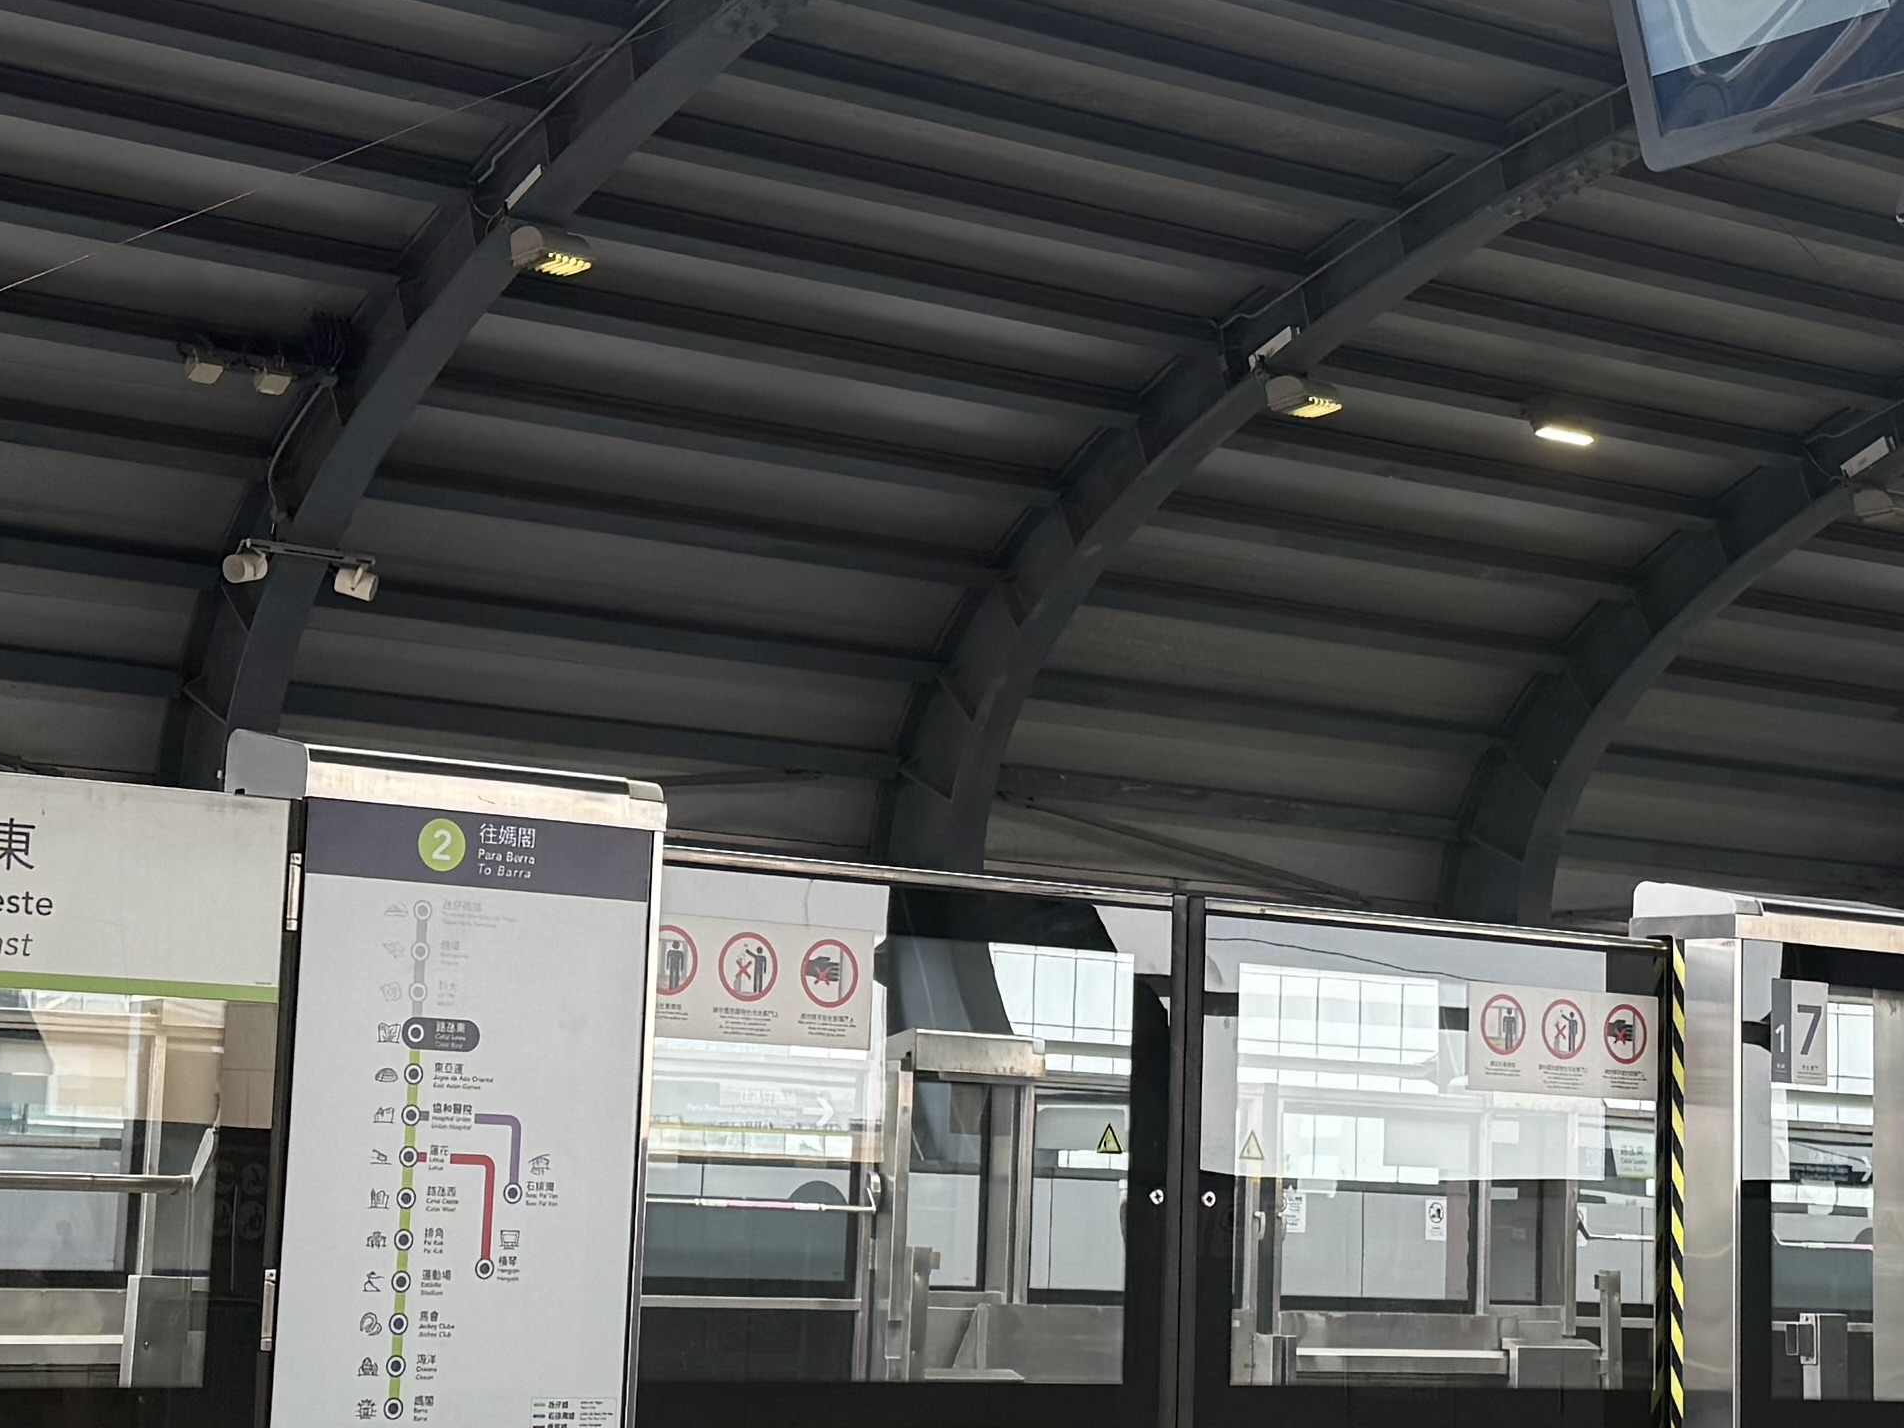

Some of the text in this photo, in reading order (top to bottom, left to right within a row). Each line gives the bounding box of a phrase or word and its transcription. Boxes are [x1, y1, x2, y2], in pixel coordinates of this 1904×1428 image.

[431, 828, 452, 861] 2
[478, 823, 536, 849] 往媽閣
[477, 848, 536, 865] Para Barra
[478, 863, 532, 879] To Barra
[1774, 1024, 1785, 1053] 1
[1797, 1004, 1822, 1055] 7
